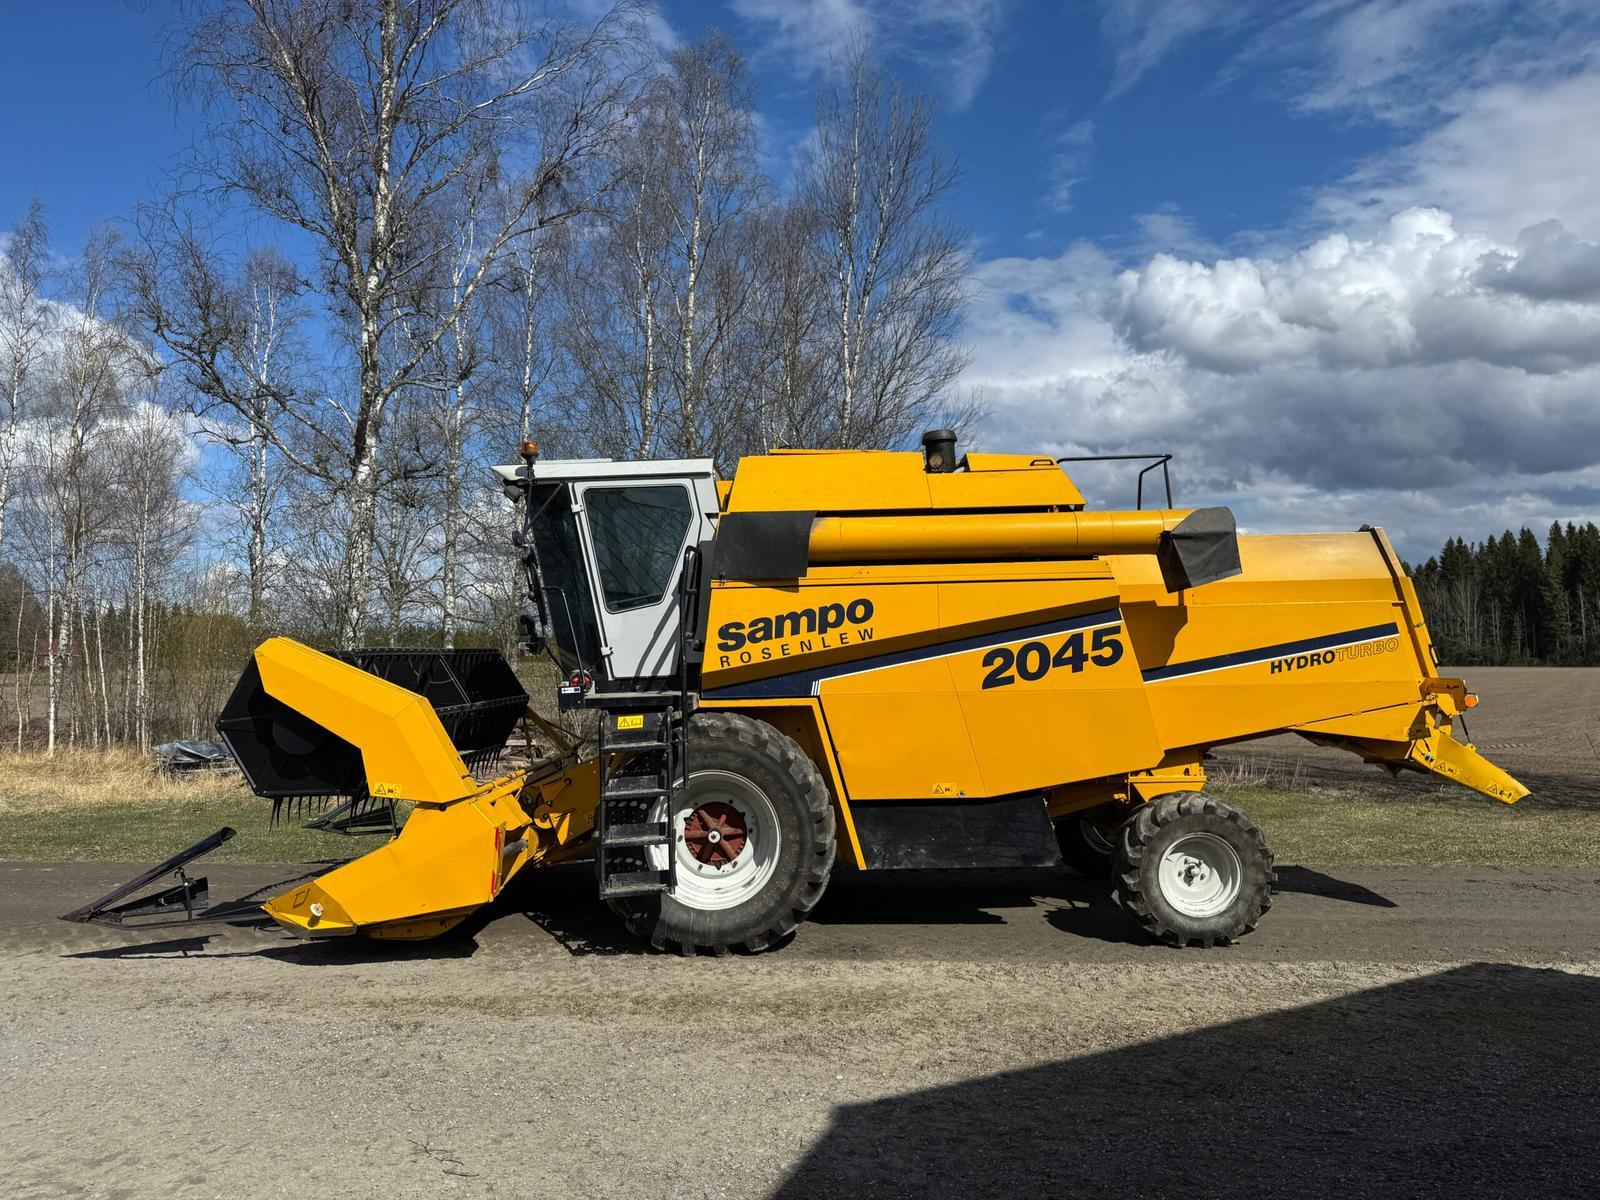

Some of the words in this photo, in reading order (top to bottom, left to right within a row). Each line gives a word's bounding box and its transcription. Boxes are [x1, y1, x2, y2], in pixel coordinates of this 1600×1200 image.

[717, 598, 874, 652] sampo
[719, 627, 874, 668] ROSENLEW
[981, 624, 1124, 690] 2045
